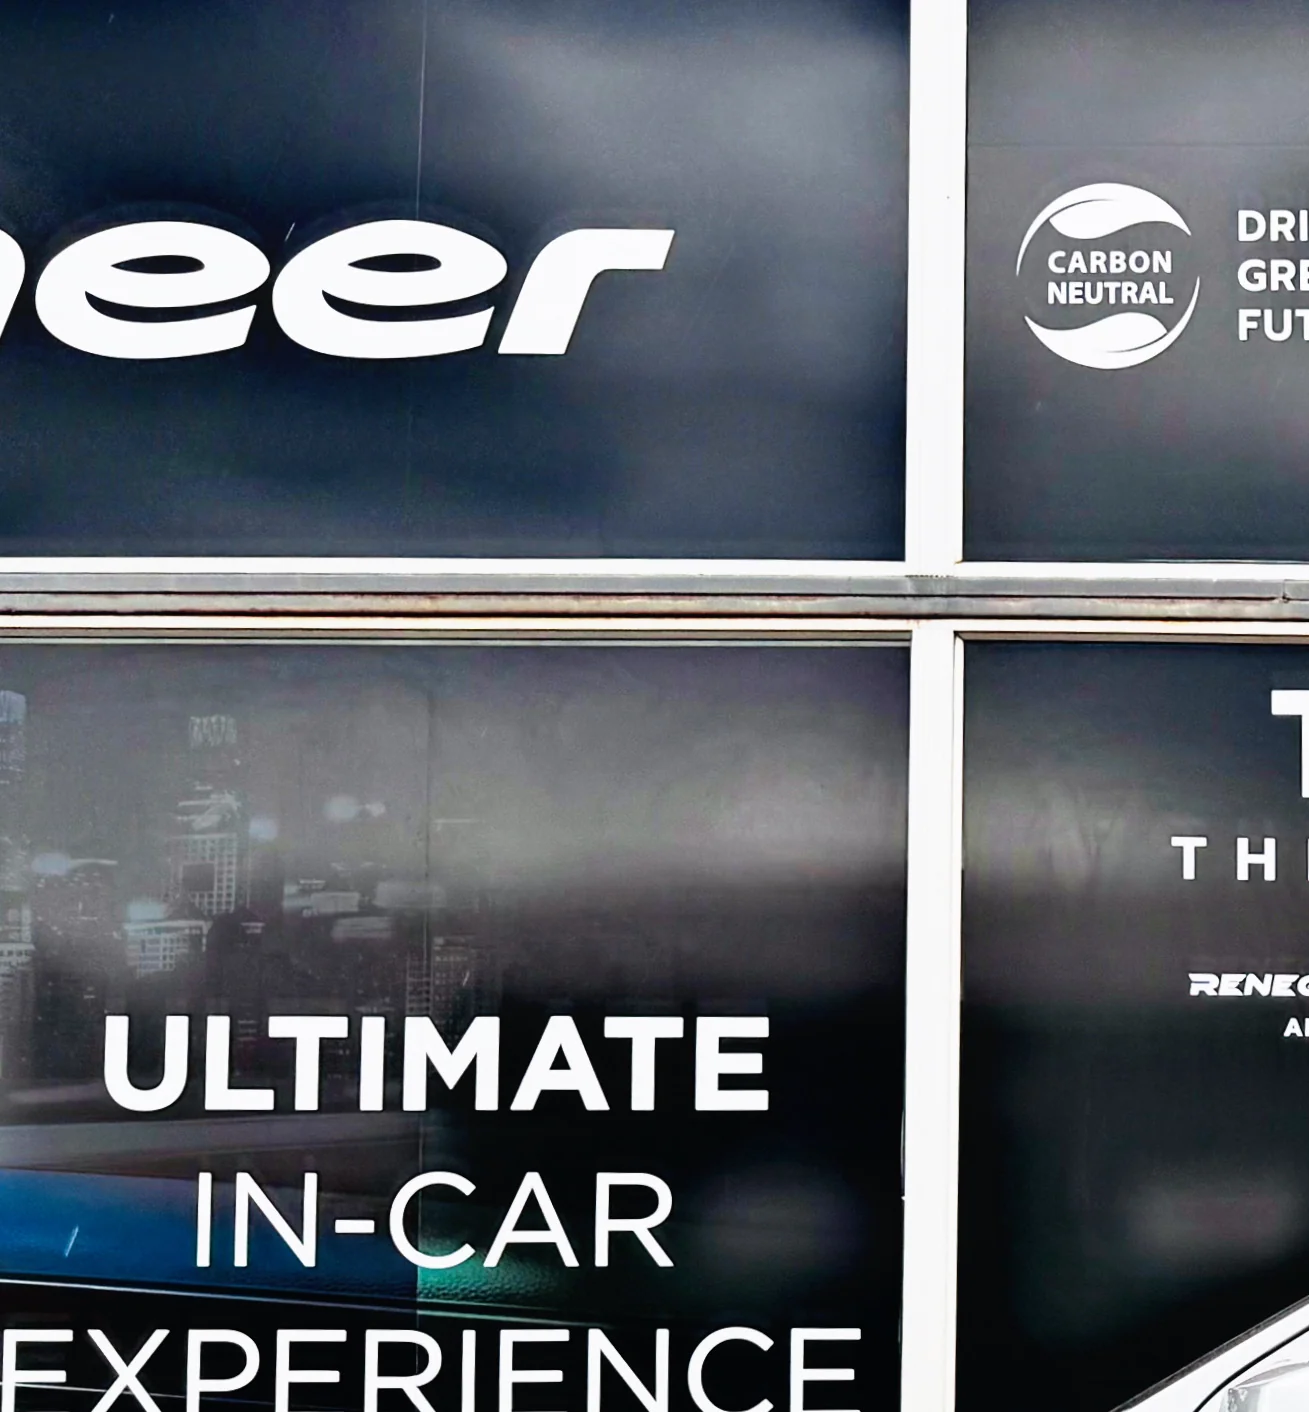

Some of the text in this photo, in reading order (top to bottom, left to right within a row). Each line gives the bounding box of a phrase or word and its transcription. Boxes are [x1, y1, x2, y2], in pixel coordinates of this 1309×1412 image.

[0, 219, 675, 359] eer
[1047, 250, 1173, 274] CARBON
[1047, 281, 1174, 305] NEUTRAL
[104, 1014, 770, 1112] ULTIMATE
[195, 1171, 675, 1270] IN-CAR
